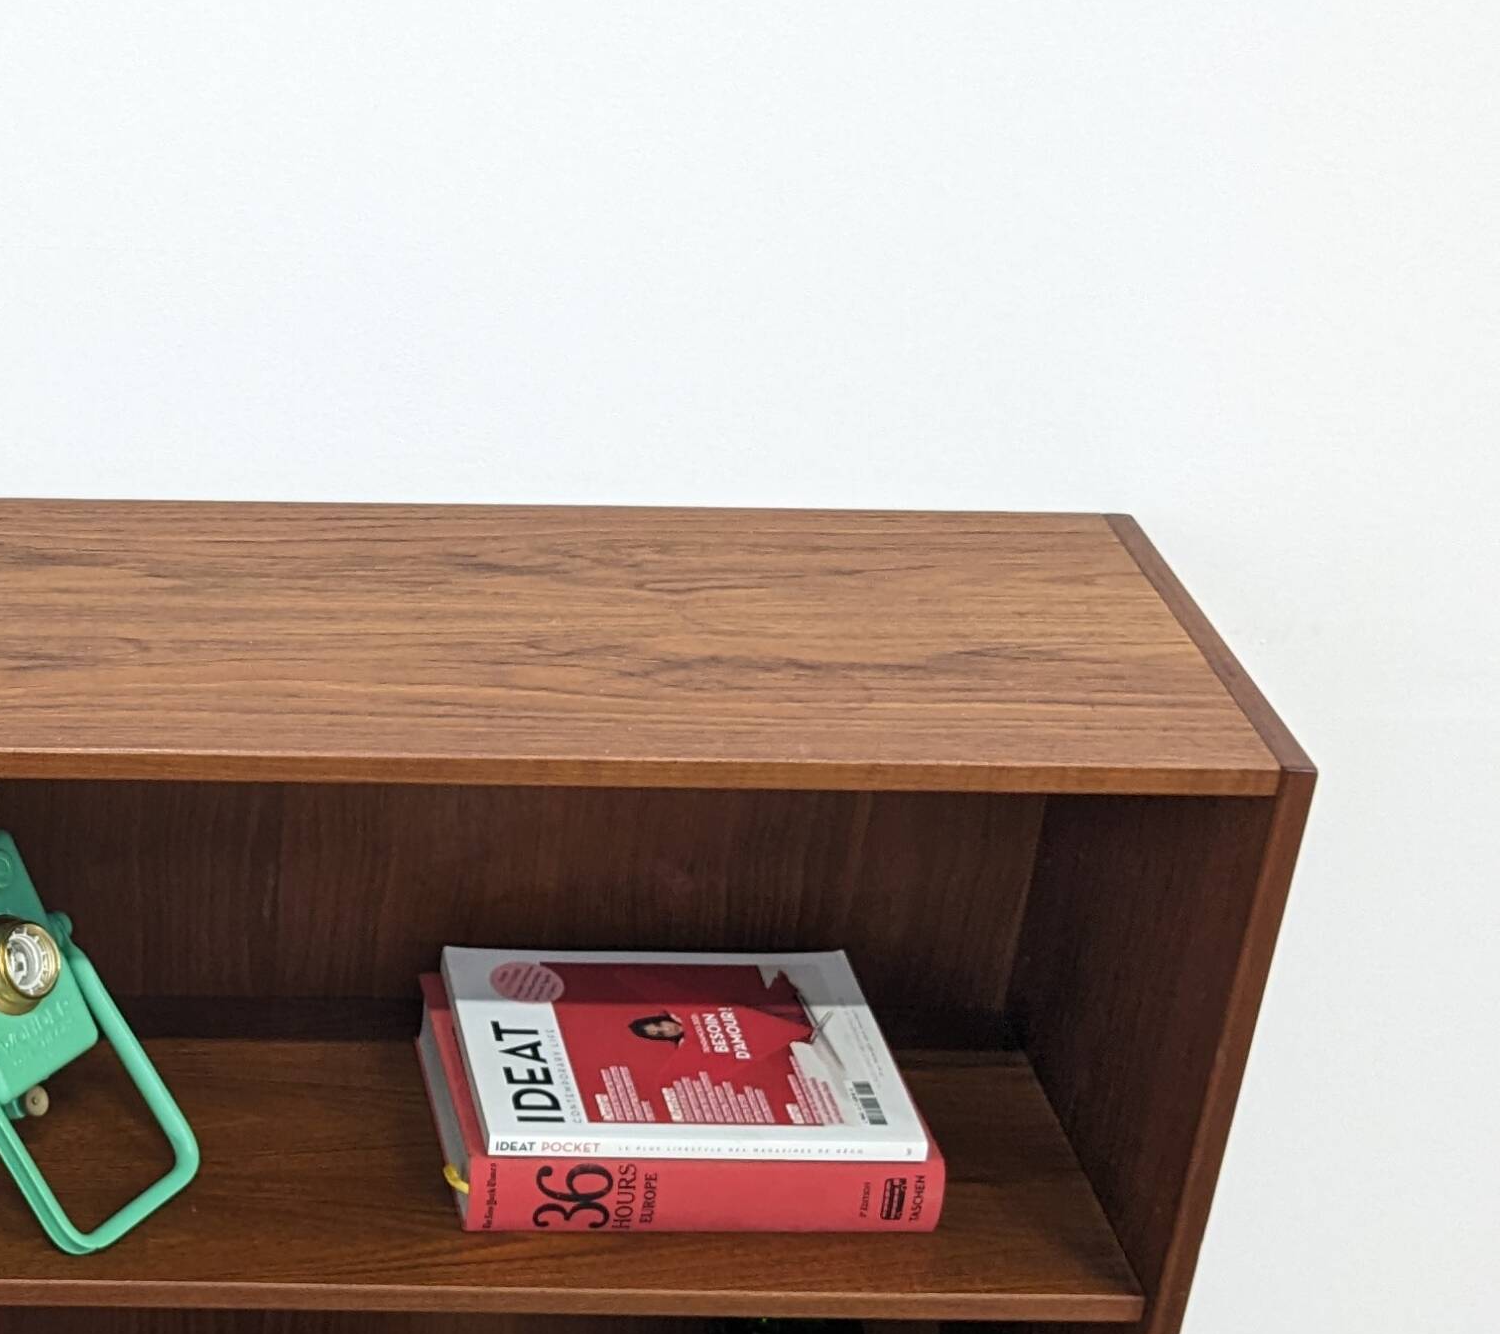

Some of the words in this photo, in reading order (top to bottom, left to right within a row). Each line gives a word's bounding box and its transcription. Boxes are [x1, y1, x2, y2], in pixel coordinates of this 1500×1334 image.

[701, 1013, 730, 1053] BESOIN
[490, 1020, 565, 1123] IDEAT
[495, 1141, 536, 1152] IDEAT
[541, 1141, 601, 1153] POCKET
[532, 1163, 614, 1228] 36
[611, 1163, 638, 1229] HOURS
[639, 1173, 658, 1224] EUROPE
[909, 1174, 926, 1223] TASCHEN
